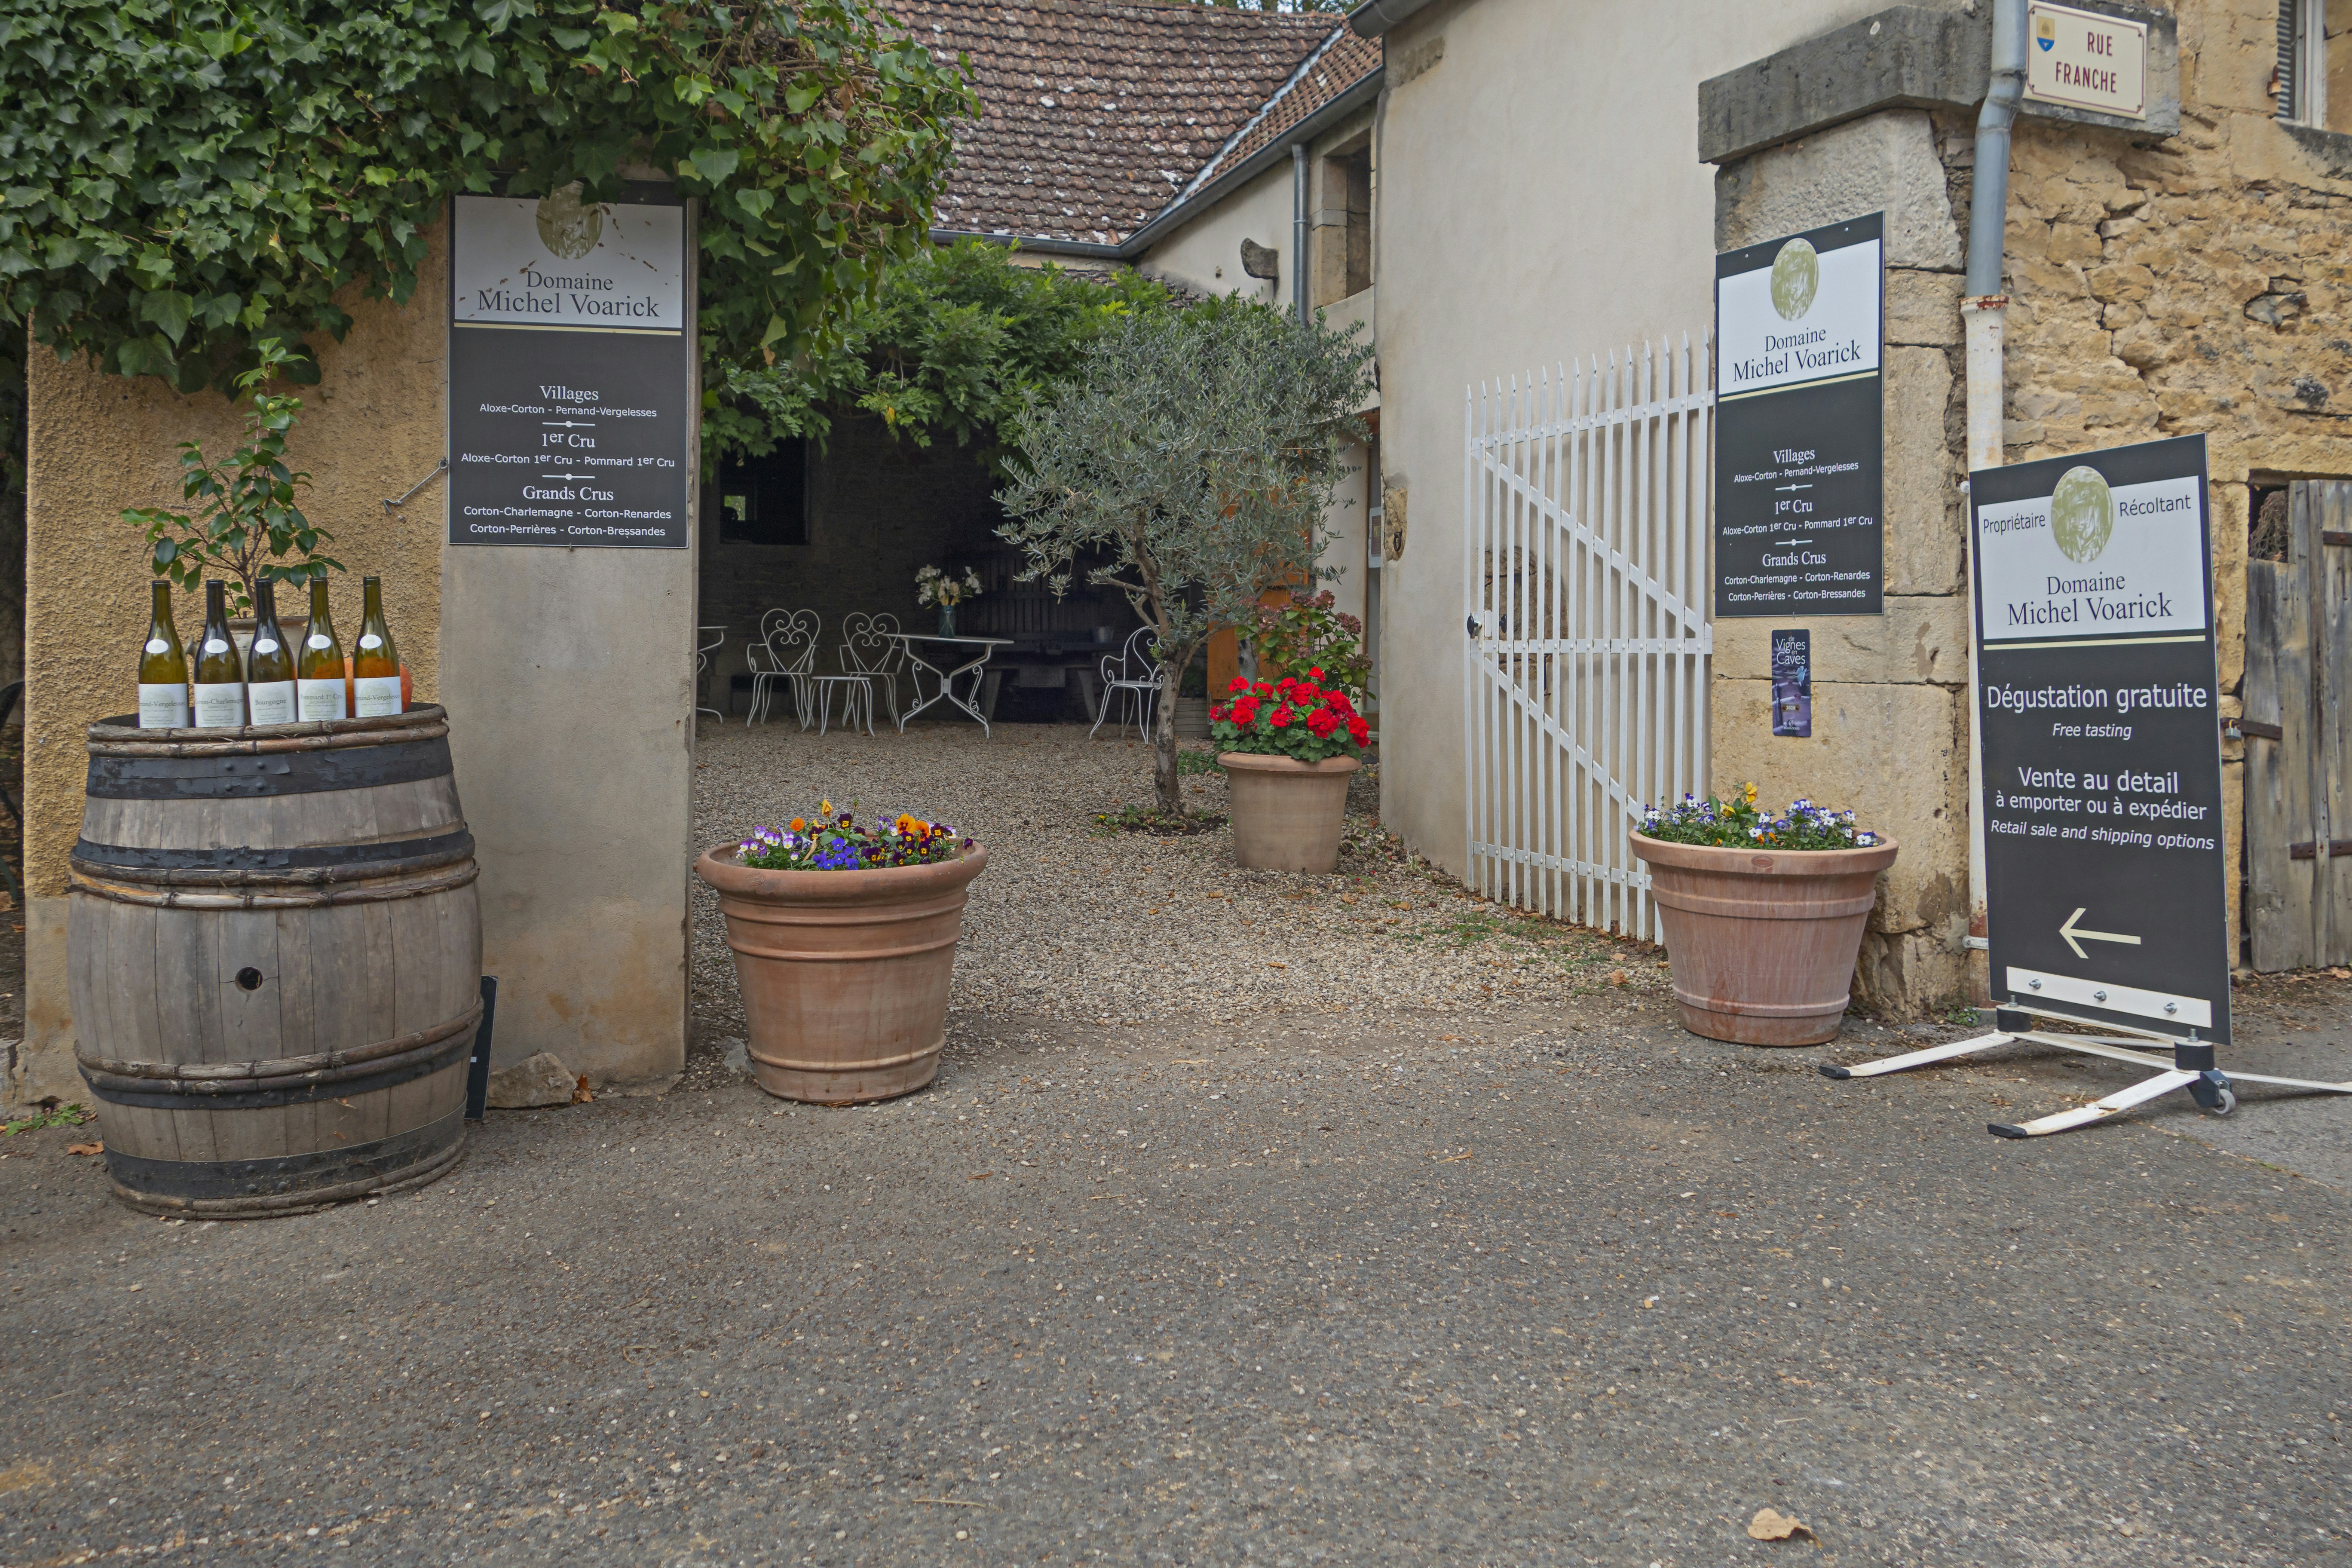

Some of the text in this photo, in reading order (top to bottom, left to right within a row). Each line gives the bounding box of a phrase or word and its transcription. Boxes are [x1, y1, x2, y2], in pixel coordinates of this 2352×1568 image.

[2088, 31, 2113, 57] RUE
[2056, 61, 2116, 93] FRANCHE
[527, 271, 613, 291] Domaine
[477, 290, 660, 317] Michel Voarick
[1765, 327, 1826, 352] Domaine
[1733, 339, 1861, 382] Michel Voarick
[540, 386, 599, 403] Villages
[480, 404, 544, 414] Aloxe-Corton
[556, 406, 657, 418] Pernand-Vergelesses
[542, 432, 595, 447] 1er Cru
[461, 453, 530, 464] Aloxe-Corton
[534, 453, 551, 464] 1er
[554, 456, 572, 465] Cru
[585, 456, 633, 466] Pommard
[637, 456, 654, 466] 1er
[657, 458, 674, 467] Cru
[1773, 448, 1815, 464] Villages
[1734, 470, 1777, 483] Aloxe-Corton
[1784, 462, 1859, 477] Pernand-Vergelesses
[523, 485, 614, 501] Grands Crus
[464, 506, 573, 519] Corton-Charlemagne
[585, 509, 671, 519] Corton-Renardes
[1775, 499, 1813, 514] 1er Cru
[1983, 494, 2192, 536] Propriétaire Récoltant
[470, 524, 556, 534] Corton-Perrières
[568, 526, 665, 536] Corton-Bressandes
[1723, 525, 1767, 536] Aloxe-Corton
[1770, 522, 1782, 532] 1er
[1783, 522, 1796, 531] Cru
[1805, 518, 1841, 530] Pommard
[1843, 516, 1856, 527] 1er
[1859, 516, 1873, 525] Cru
[1762, 551, 1826, 567] Grands Crus
[1724, 574, 1797, 585] Corton-Charlemagne
[1805, 570, 1870, 582] Corton-Renardes
[2046, 572, 2125, 595] Domaine
[1728, 591, 1785, 601] Corton-Perrières
[1793, 588, 1865, 600] Corton-Bressandes
[2007, 592, 2173, 625] Michel Voarick
[1776, 638, 1805, 653] Vignes
[1776, 652, 1805, 665] Caves
[1988, 683, 2207, 713] Dégustation gratuite
[2052, 723, 2132, 740] Free tasting
[2018, 766, 2075, 788] Vente
[2083, 774, 2108, 790] au
[1996, 790, 2207, 821] à emporter ou à expédier
[1991, 819, 2214, 850] Retail sale and shipping options
